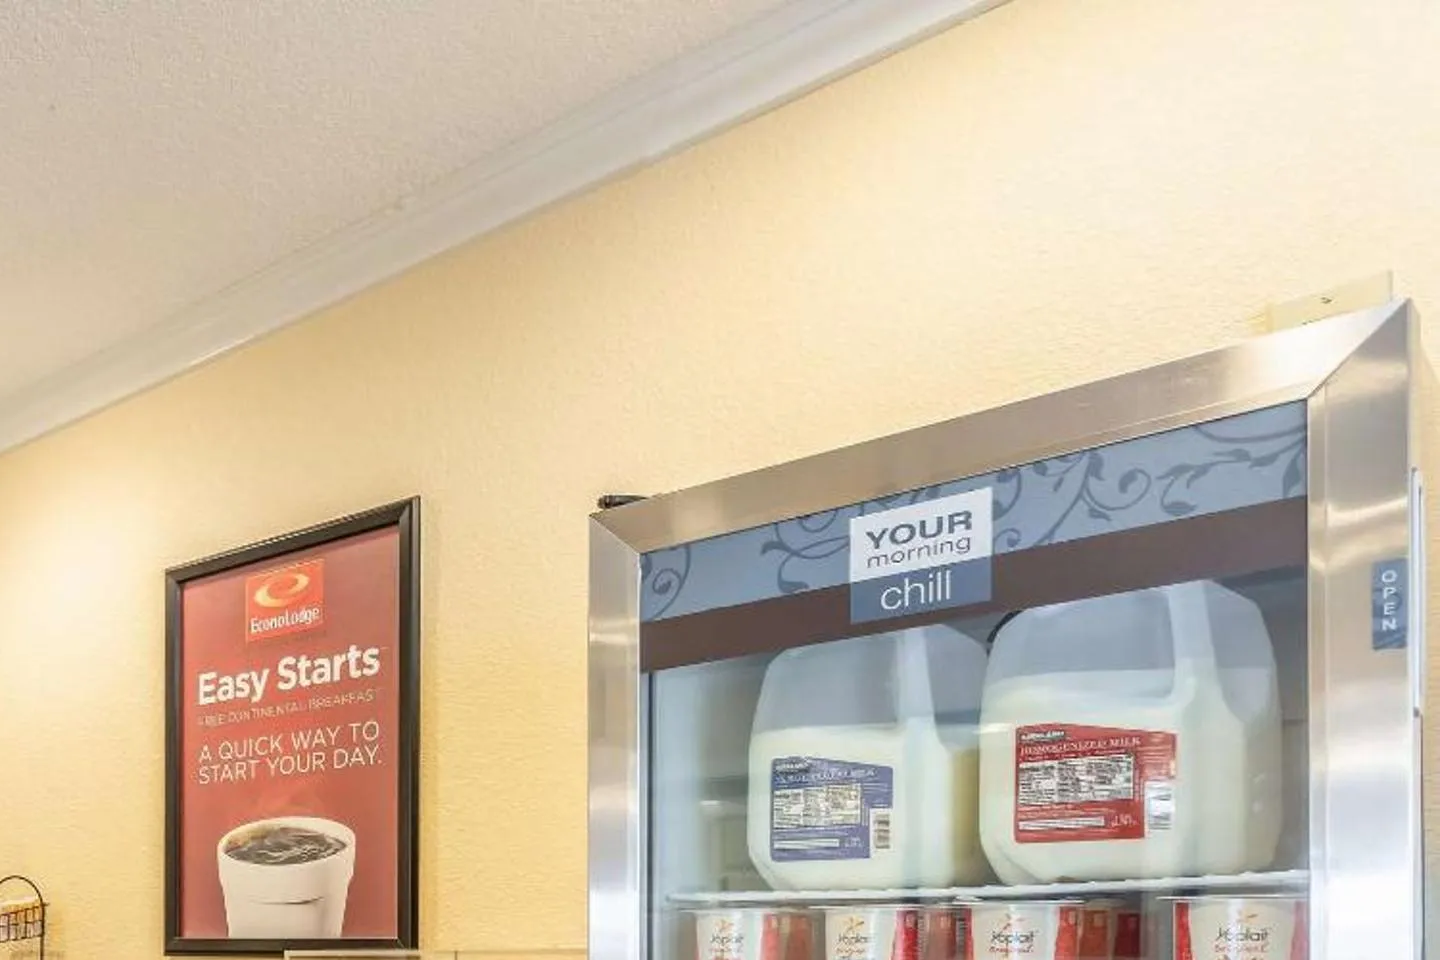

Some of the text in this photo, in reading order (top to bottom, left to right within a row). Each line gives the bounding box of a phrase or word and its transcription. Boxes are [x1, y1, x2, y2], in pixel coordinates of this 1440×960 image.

[865, 510, 972, 550] YOUR
[866, 536, 971, 569] morning
[880, 569, 951, 610] chill
[1381, 569, 1398, 631] OPEN
[197, 644, 380, 705] Easy Starts
[308, 688, 378, 711] BREAKFAS
[198, 720, 379, 763] A QUICK WAY TO
[1110, 735, 1142, 749] MILK
[198, 745, 382, 785] START YOUR DAY.
